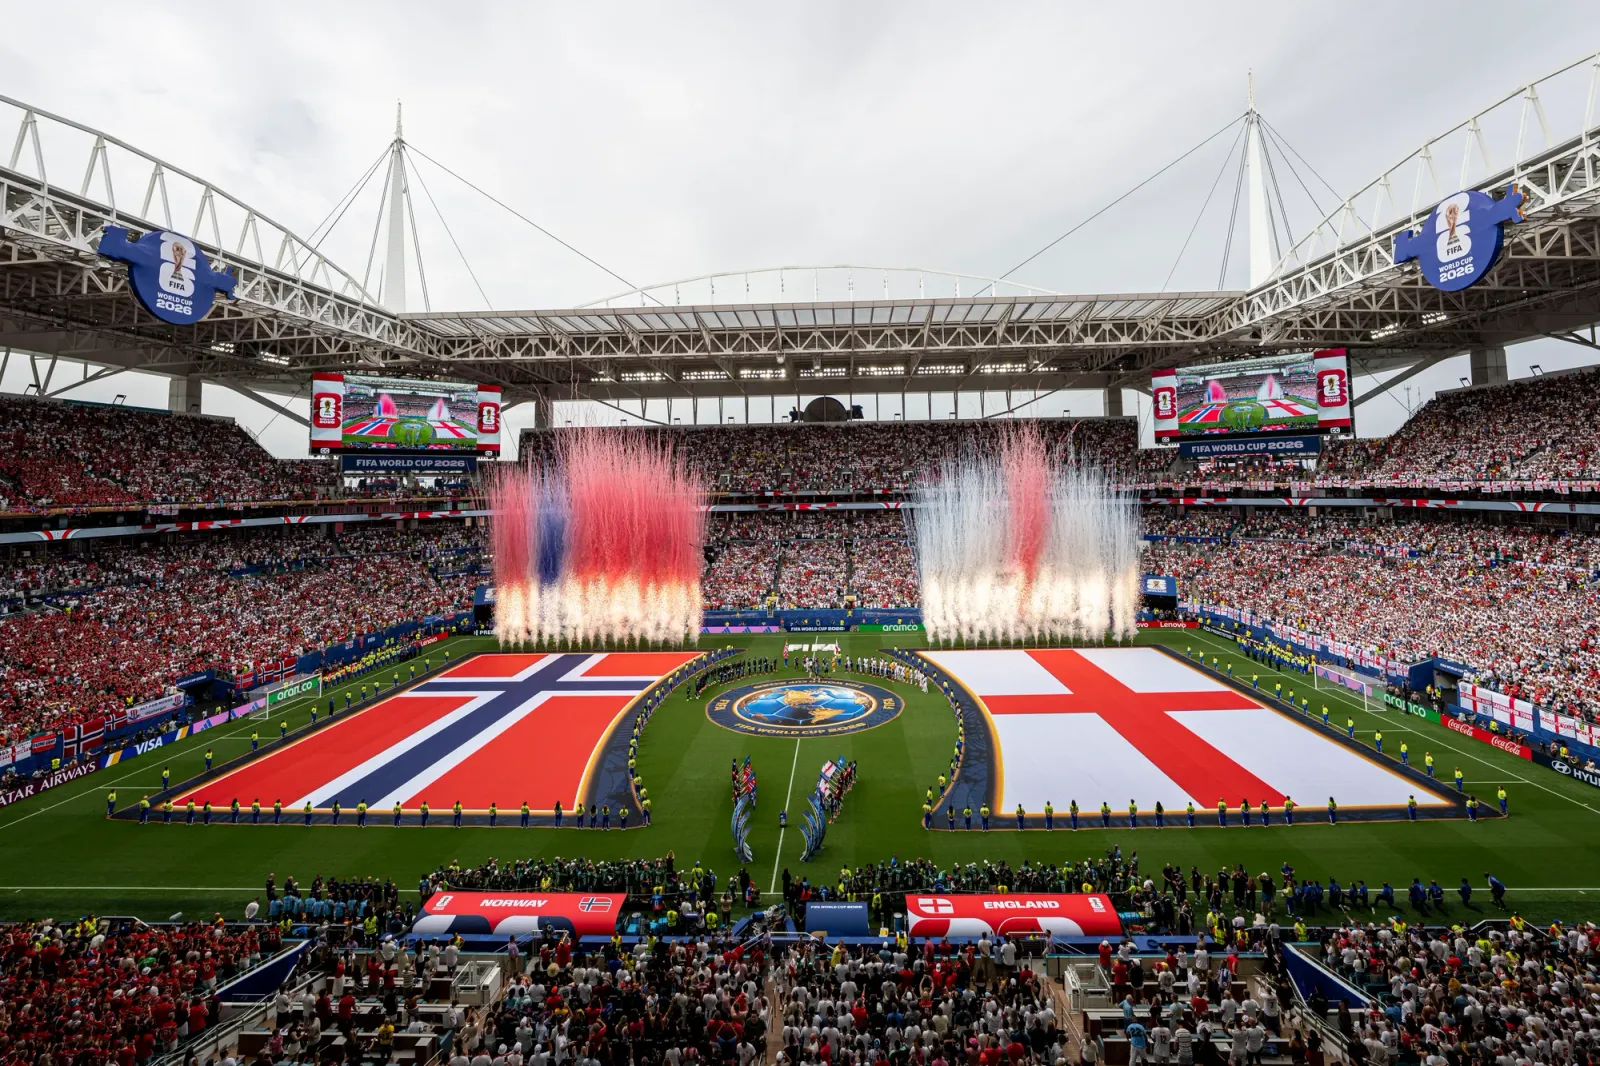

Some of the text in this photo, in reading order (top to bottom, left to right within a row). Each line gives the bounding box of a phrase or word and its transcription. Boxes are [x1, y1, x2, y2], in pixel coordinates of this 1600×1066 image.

[1446, 245, 1463, 256] FIFA
[1438, 256, 1474, 273] WORLD CUP
[1439, 264, 1475, 283] 2026
[168, 280, 186, 292] FIFA
[157, 292, 193, 307] WORLD CUP
[156, 299, 193, 316] 2026
[1191, 441, 1304, 453] FIFA WORLD CUP 2026
[356, 459, 466, 468] FIFA WORLD CUP 2026
[882, 624, 918, 632] aramco
[420, 637, 438, 646] Lenovo
[788, 643, 840, 652] FIFA
[734, 723, 756, 731] FIFA
[757, 727, 800, 735] WORLD
[828, 722, 867, 733] 2026
[133, 735, 163, 755] VISA
[40, 761, 96, 792] AIRWAYS
[1573, 768, 1600, 787] HYU
[480, 899, 549, 907] NORWAY
[983, 900, 1060, 909] ENGLAND
[1130, 1027, 1142, 1037] 22
